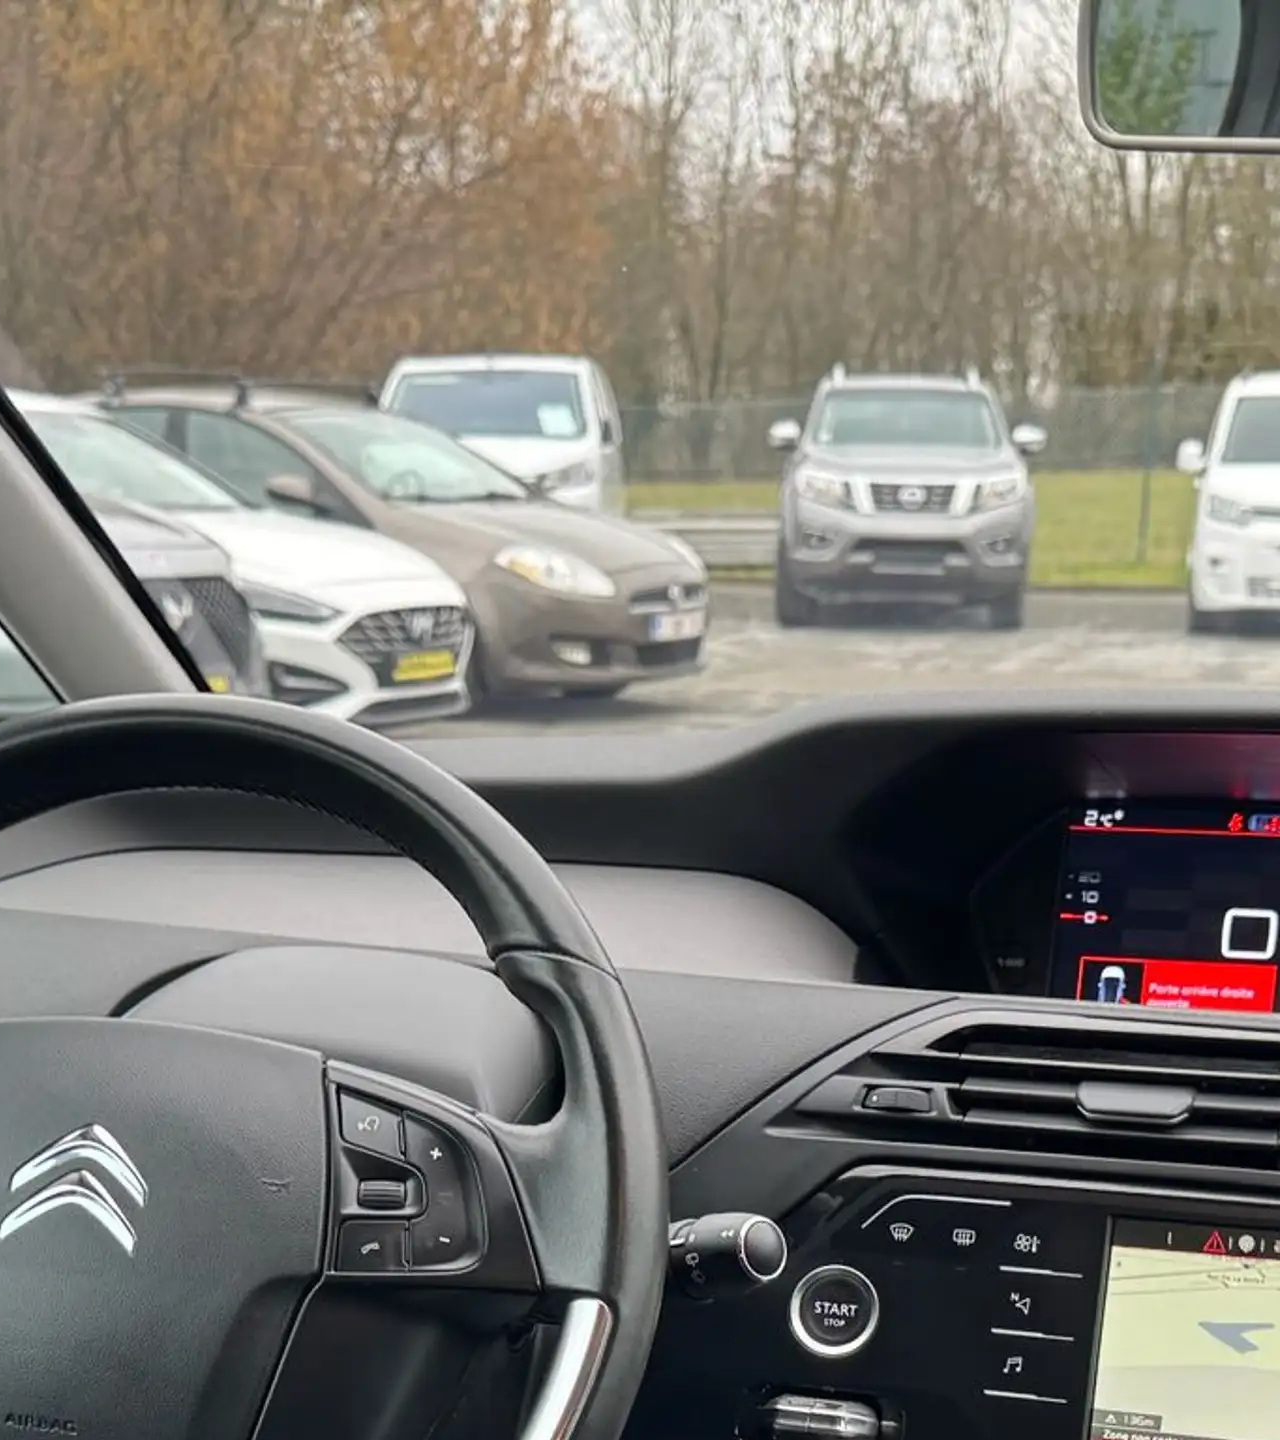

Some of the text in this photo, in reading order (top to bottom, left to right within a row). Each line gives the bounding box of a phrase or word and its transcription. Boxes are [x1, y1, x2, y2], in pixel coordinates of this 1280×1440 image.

[1081, 889, 1100, 904] 10
[1083, 910, 1097, 924] 0
[814, 1300, 858, 1318] START
[823, 1317, 846, 1328] STOP
[5, 1413, 78, 1436] AIRBAG
